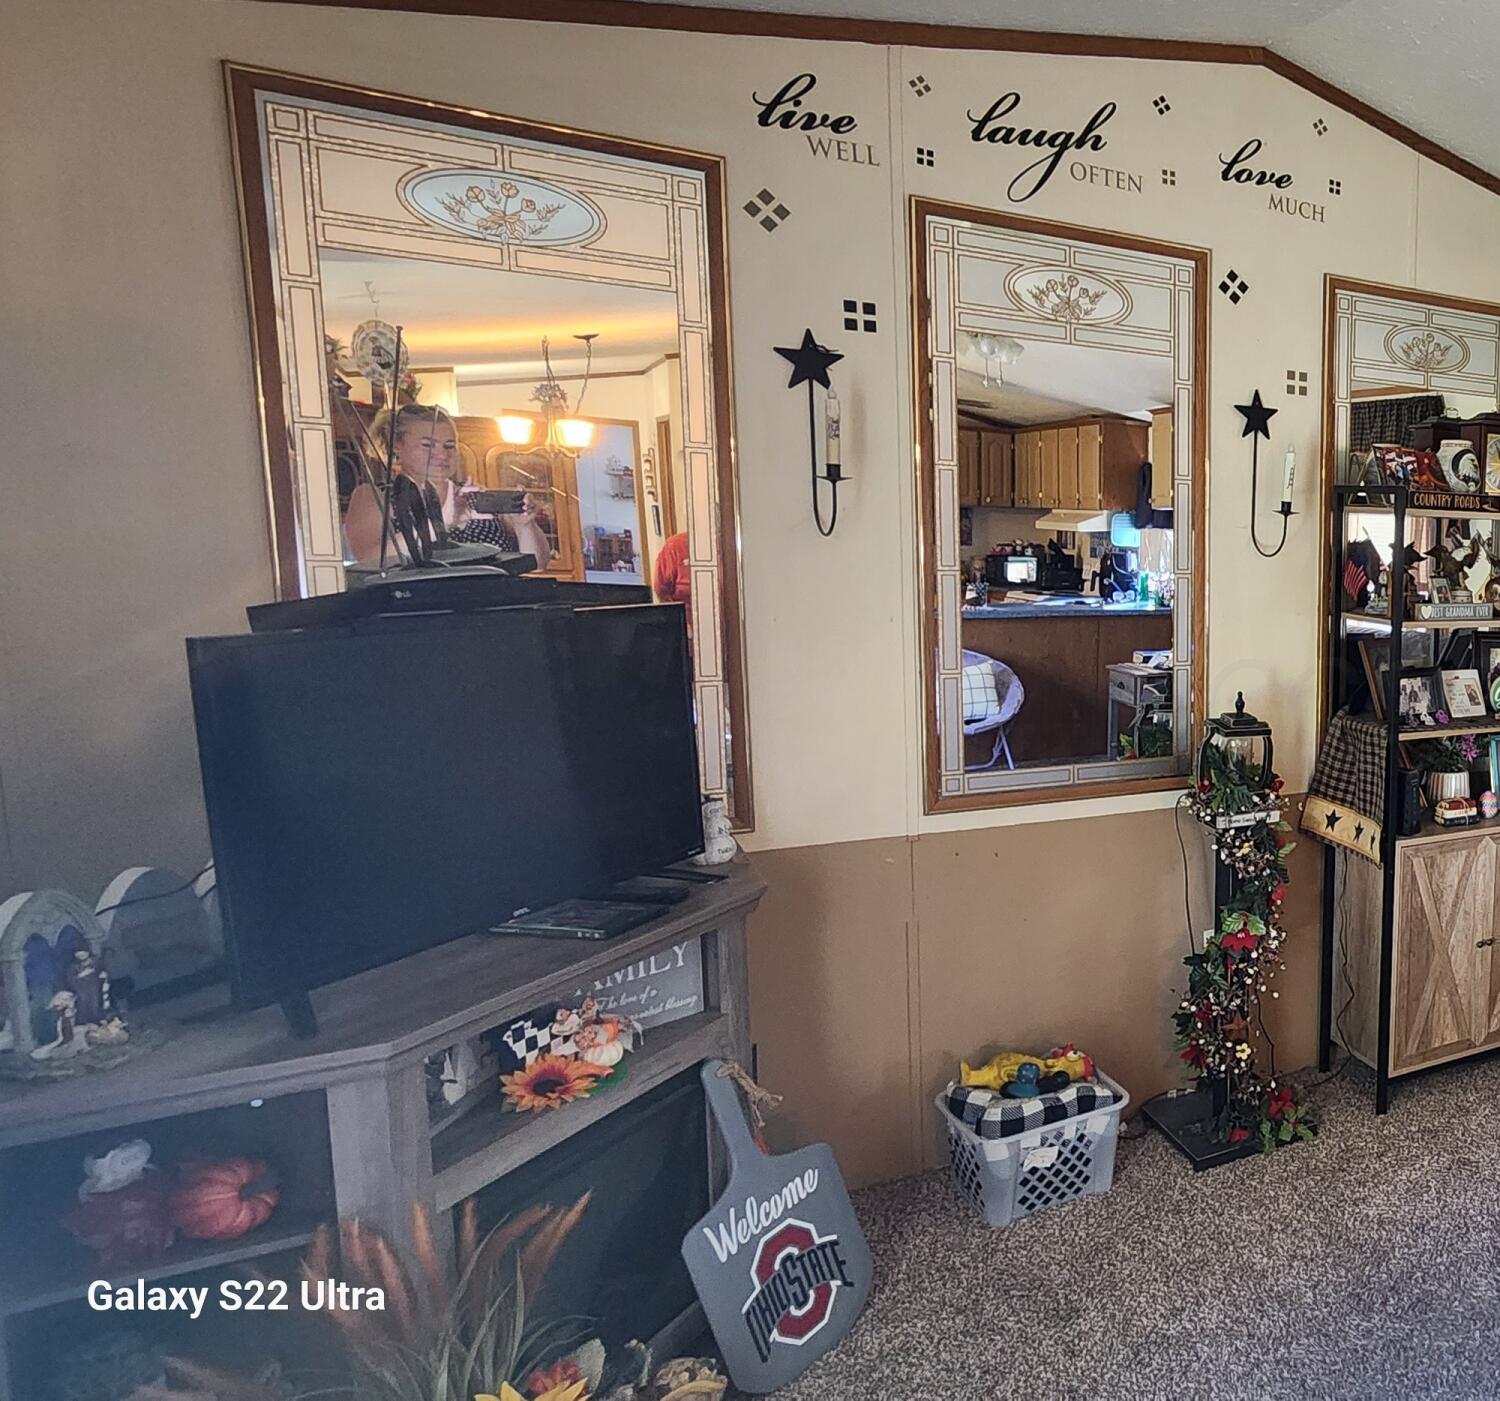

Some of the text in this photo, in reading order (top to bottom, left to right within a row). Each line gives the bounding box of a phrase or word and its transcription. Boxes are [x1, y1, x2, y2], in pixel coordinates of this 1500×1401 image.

[751, 73, 858, 134] live
[805, 135, 881, 168] WELL
[966, 92, 1117, 203] laugh
[1218, 138, 1294, 190] love
[1070, 161, 1144, 194] OFTEN
[1267, 193, 1326, 224] MUCH
[1413, 492, 1453, 507] COUNTRY
[1454, 495, 1481, 510] ROADS
[1431, 604, 1489, 617] BEST GRANDMA EVER
[703, 1168, 819, 1263] Welcome
